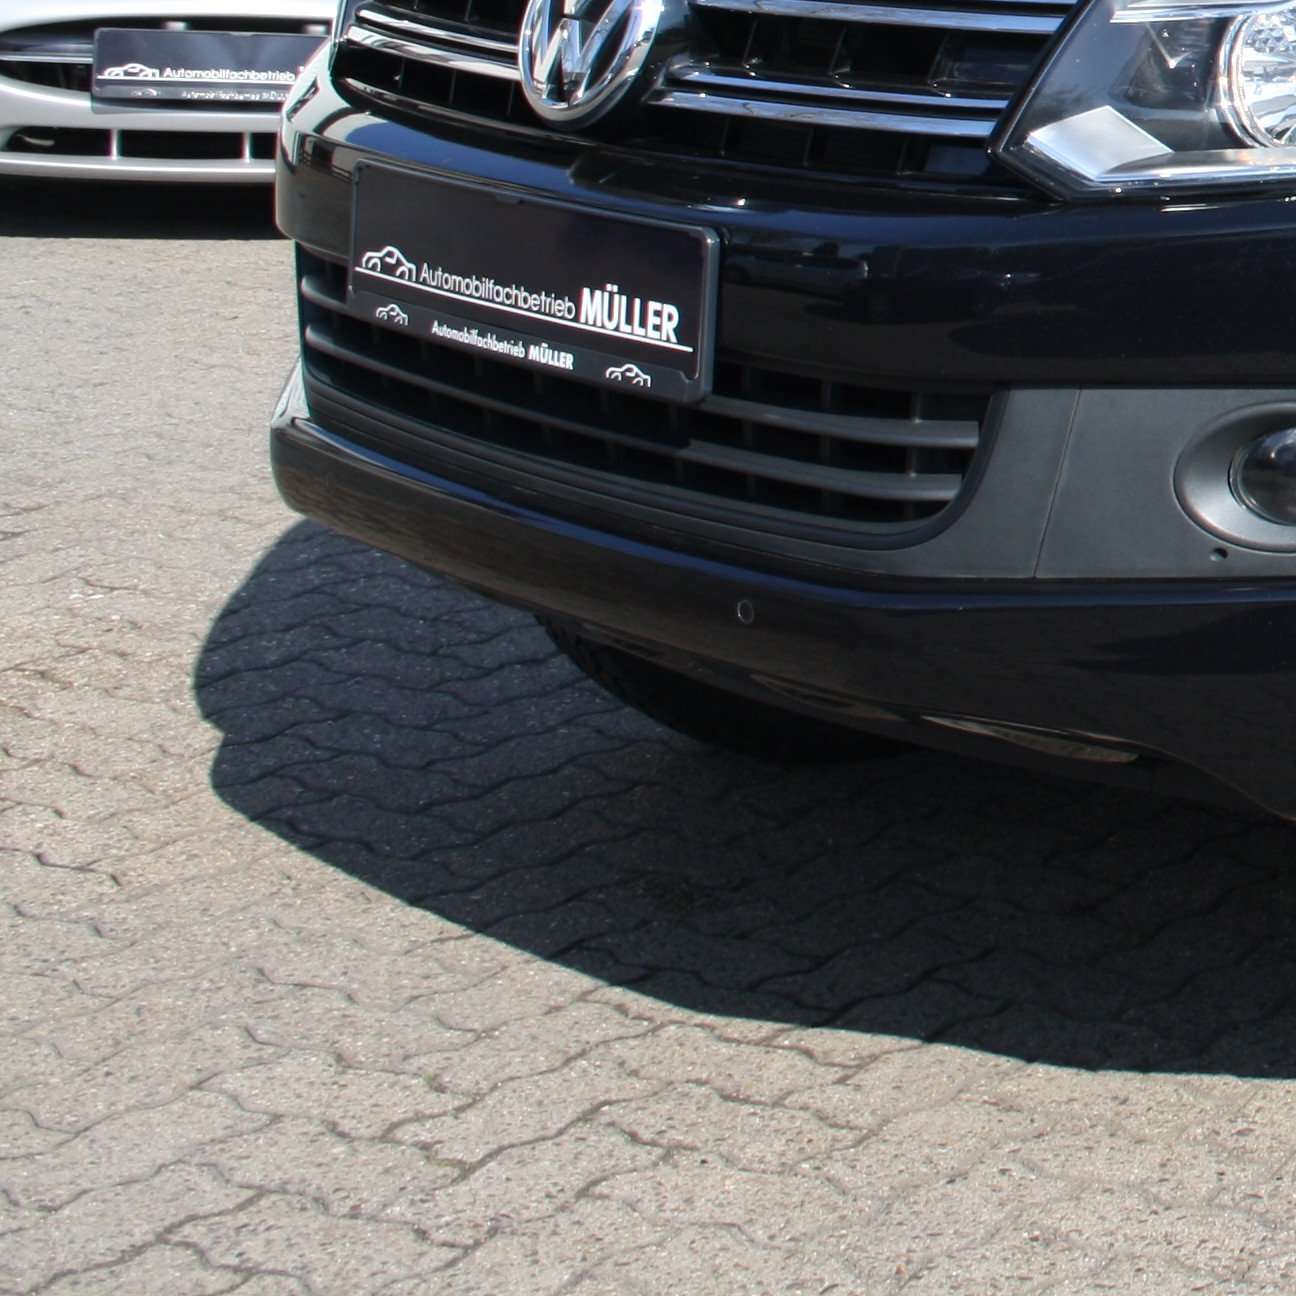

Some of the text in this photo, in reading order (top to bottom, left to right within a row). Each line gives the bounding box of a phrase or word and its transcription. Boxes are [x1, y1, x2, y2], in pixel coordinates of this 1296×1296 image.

[163, 66, 296, 82] Automobilfachbetrieb
[419, 262, 679, 343] Automobilfachbetrieb MÜLLER
[432, 320, 574, 371] Automobilfachbetrieb MÜLLER
